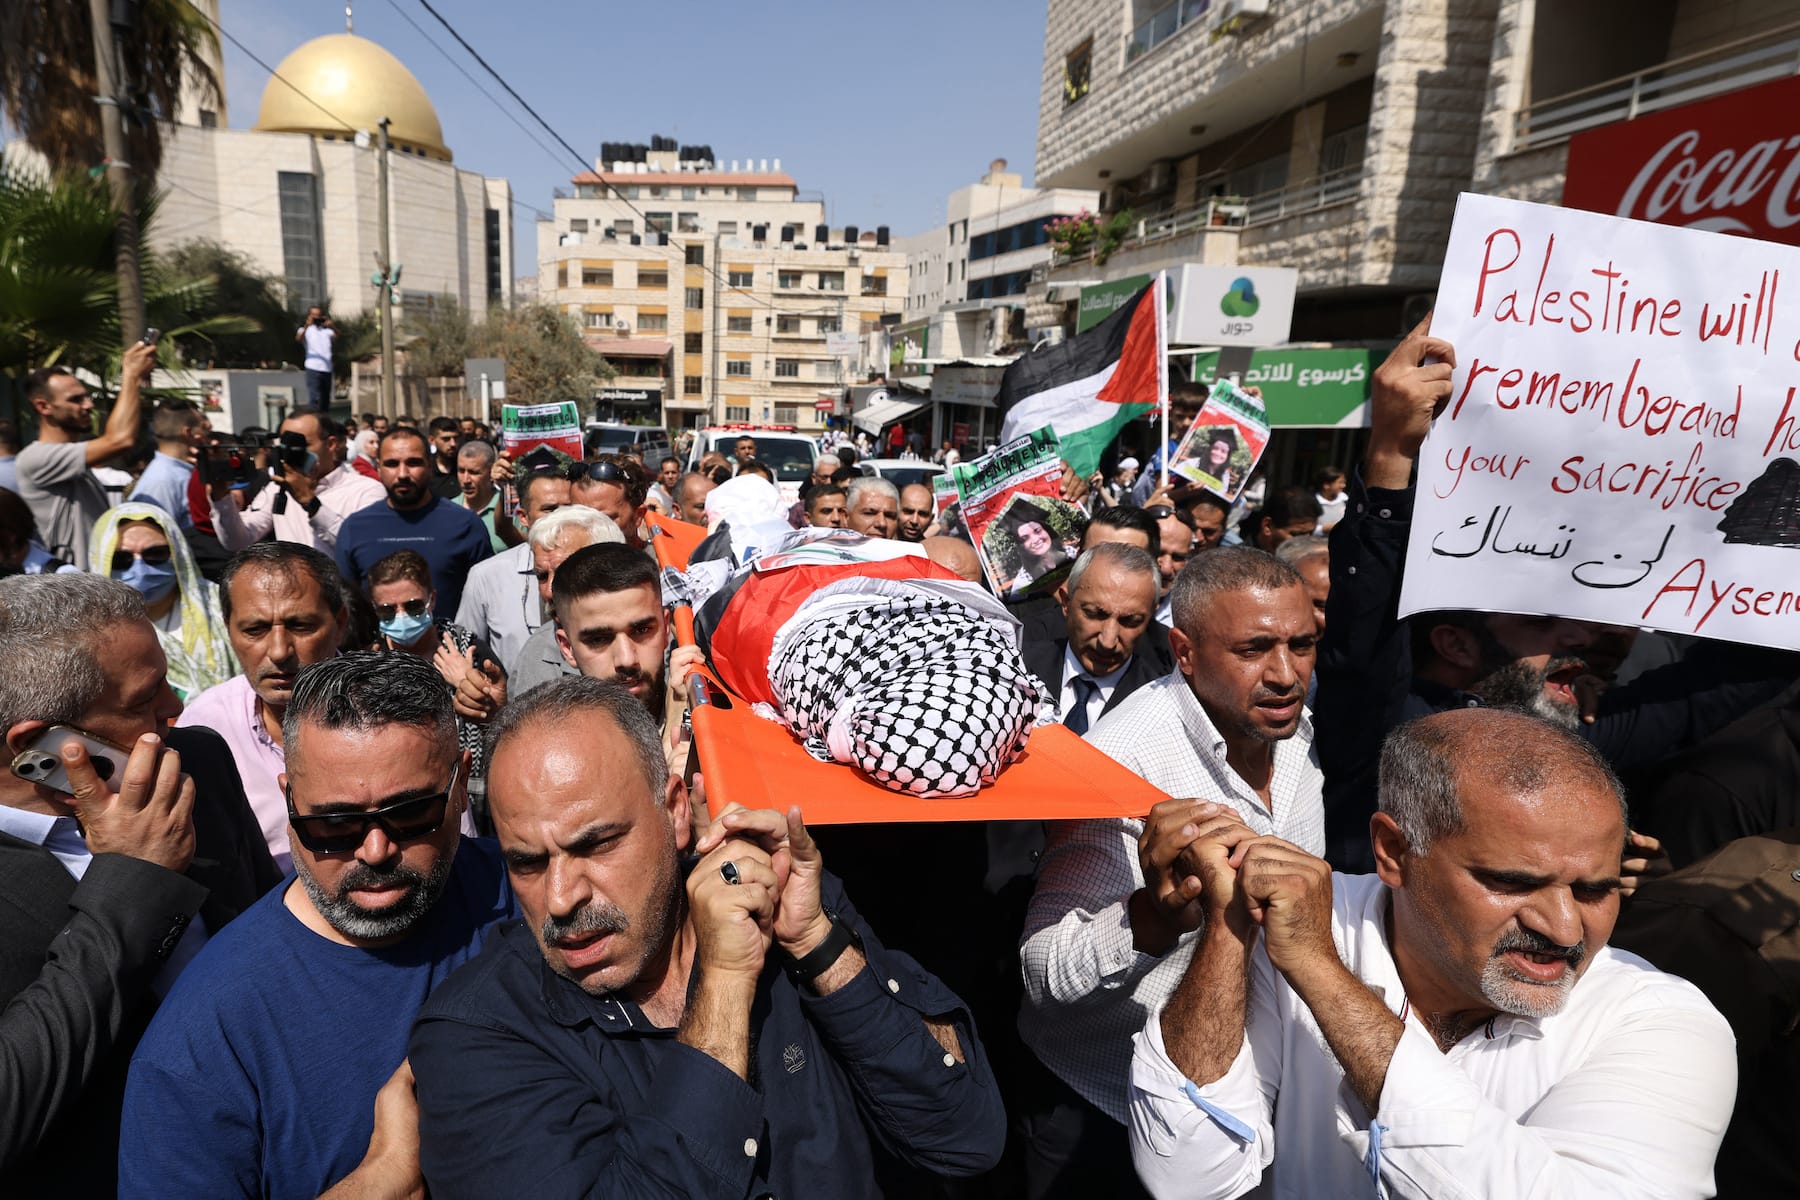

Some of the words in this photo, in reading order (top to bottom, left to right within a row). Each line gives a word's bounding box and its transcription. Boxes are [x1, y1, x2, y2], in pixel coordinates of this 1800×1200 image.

[1472, 228, 1683, 337] Palestine
[1699, 269, 1779, 356] will
[1201, 362, 1294, 384] للاتصت
[1297, 362, 1367, 387] كرسوع
[1434, 445, 1531, 500] your
[1551, 441, 1742, 512] sacrifice
